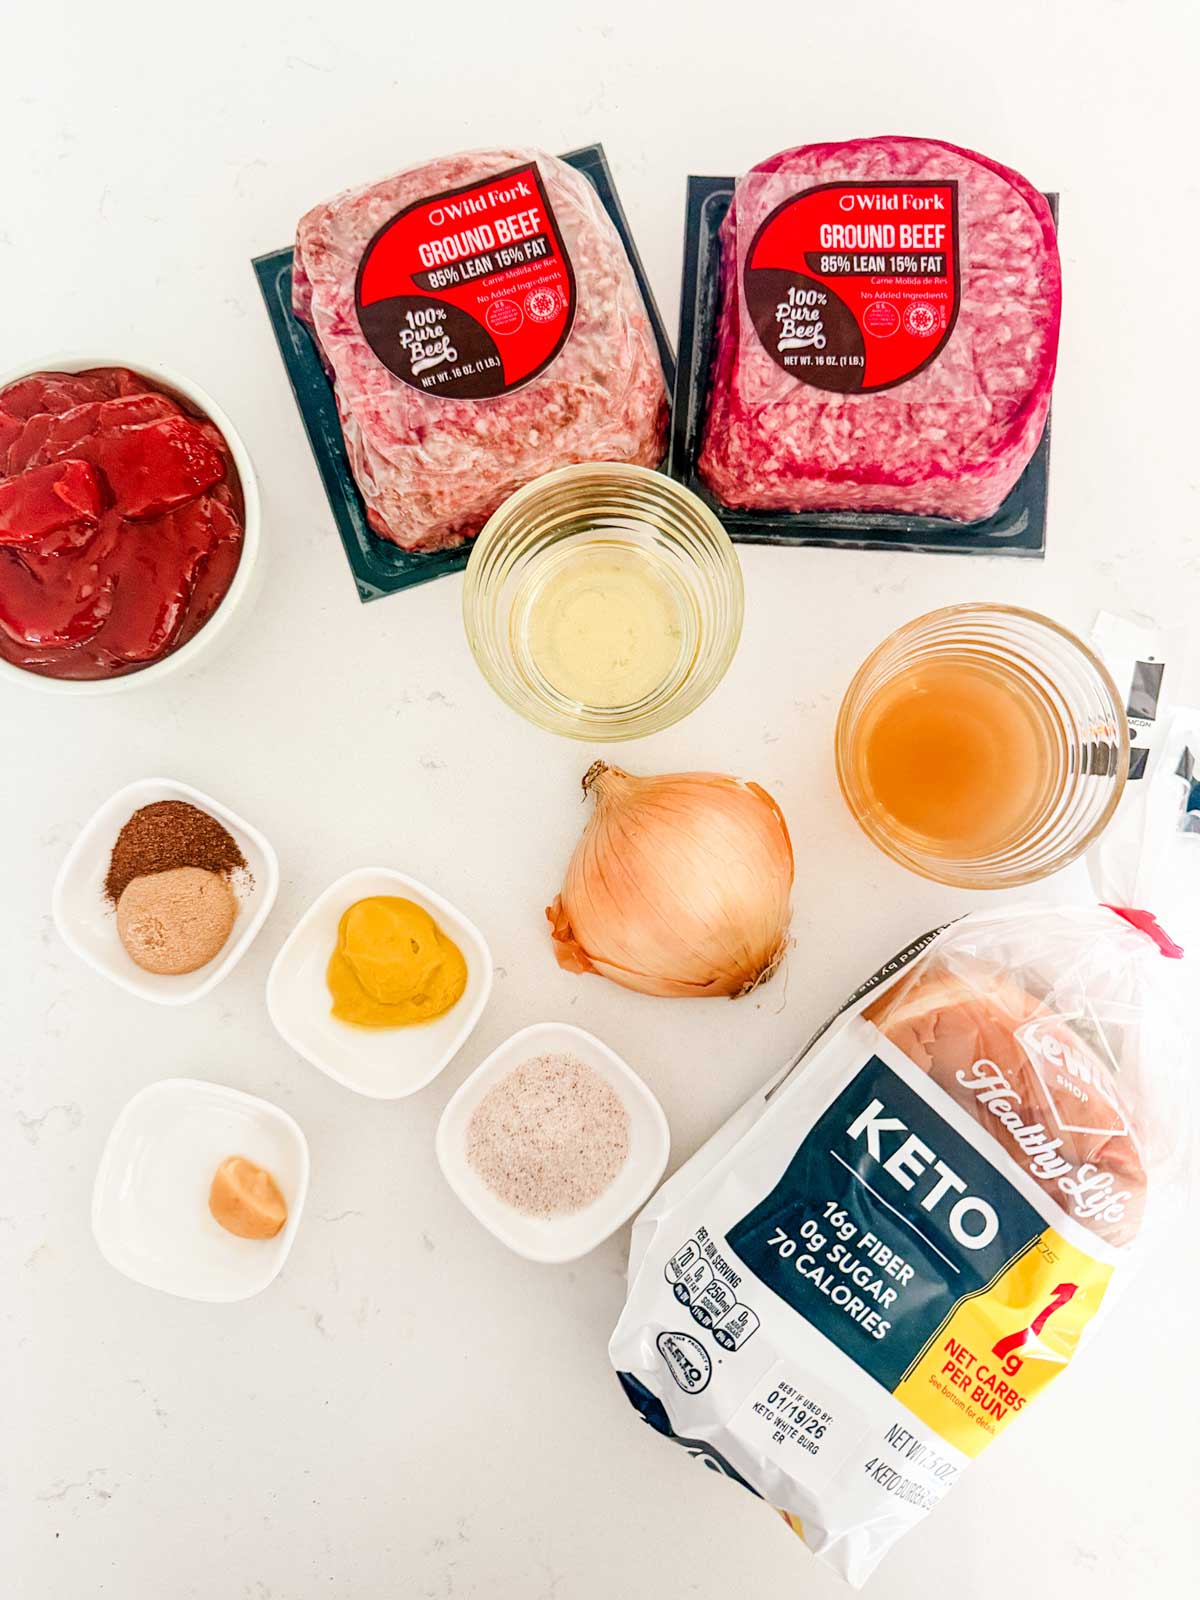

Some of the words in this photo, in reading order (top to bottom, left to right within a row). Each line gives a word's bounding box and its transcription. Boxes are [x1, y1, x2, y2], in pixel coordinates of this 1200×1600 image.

[444, 195, 487, 220] Wild
[488, 181, 532, 206] Fork
[857, 194, 899, 210] Wild
[902, 194, 945, 210] Fork
[418, 224, 495, 267] GROUND
[494, 208, 541, 244] BEEF
[820, 224, 895, 249] GROUND
[900, 224, 945, 249] BEEF
[428, 267, 459, 289] 85%
[459, 255, 494, 279] LEAN
[495, 246, 524, 269] 15%
[526, 238, 548, 259] FAT
[482, 274, 504, 287] Carne
[505, 265, 532, 281] Molida
[532, 263, 543, 271] de
[543, 258, 558, 267] Res
[820, 256, 850, 273] 85%
[853, 256, 885, 272] LEAN
[889, 256, 918, 273] 15%
[920, 256, 943, 272] FAT
[477, 294, 489, 304] No
[490, 286, 517, 300] Added
[517, 272, 562, 292] Ingredients
[871, 277, 894, 285] Carne
[895, 277, 921, 285] Molida
[922, 277, 933, 285] de
[934, 277, 948, 285] Res
[788, 287, 827, 306] 100%
[861, 291, 872, 299] No
[874, 291, 900, 299] Added
[902, 291, 948, 301] Ingredients
[405, 308, 447, 330] 100%
[775, 303, 820, 322] Pure
[399, 325, 444, 349] Pure
[779, 319, 826, 346] Beef
[410, 336, 457, 367] Beef
[784, 356, 800, 366] NET
[800, 356, 814, 366] WT.
[815, 356, 825, 366] 16
[826, 356, 838, 366] OZ.
[840, 356, 848, 367] (1
[848, 356, 865, 367] LB.)
[421, 374, 437, 388] NET
[437, 370, 452, 382] WT.
[452, 367, 462, 378] 16
[463, 364, 476, 376] OZ.
[477, 360, 485, 372] (1
[484, 356, 501, 370] LB.)
[900, 926, 945, 963] ertified
[881, 962, 899, 976] by
[1056, 1074, 1089, 1103] SHOP
[955, 1059, 1073, 1179] Healthy
[1057, 1162, 1132, 1222] Life
[846, 1098, 999, 1250] KETO
[695, 1226, 709, 1241] PER
[702, 1238, 710, 1247] 1
[822, 1201, 857, 1241] 16g
[857, 1232, 915, 1287] FIBER
[678, 1246, 694, 1267] 70
[704, 1242, 718, 1260] BUN
[800, 1220, 828, 1252] 0g
[826, 1244, 898, 1310] SUGAR
[694, 1266, 705, 1281] 0g
[711, 1255, 742, 1289] SERVING
[767, 1227, 797, 1258] 70
[795, 1255, 892, 1340] CALORIES
[689, 1282, 700, 1294] FAT
[706, 1282, 730, 1313] 250mg
[701, 1296, 722, 1318] SODIUM
[737, 1311, 749, 1327] 0g
[663, 1337, 702, 1381] KETO
[944, 1338, 978, 1369] NET
[975, 1366, 1027, 1412] CARBS
[778, 1381, 797, 1398] BEST
[796, 1394, 805, 1403] IF
[803, 1399, 822, 1416] USED
[820, 1411, 834, 1426] BY:
[929, 1374, 942, 1390] See
[941, 1385, 965, 1410] bottom
[965, 1405, 976, 1418] for
[941, 1361, 971, 1393] PER
[971, 1387, 1008, 1421] BUN
[767, 1390, 827, 1440] 01/19/26
[772, 1431, 785, 1445] ER
[773, 1415, 799, 1439] WHITE
[797, 1434, 820, 1456] BURG
[884, 1423, 914, 1452] NET
[865, 1457, 879, 1473] 4
[870, 1462, 902, 1491] KETO
